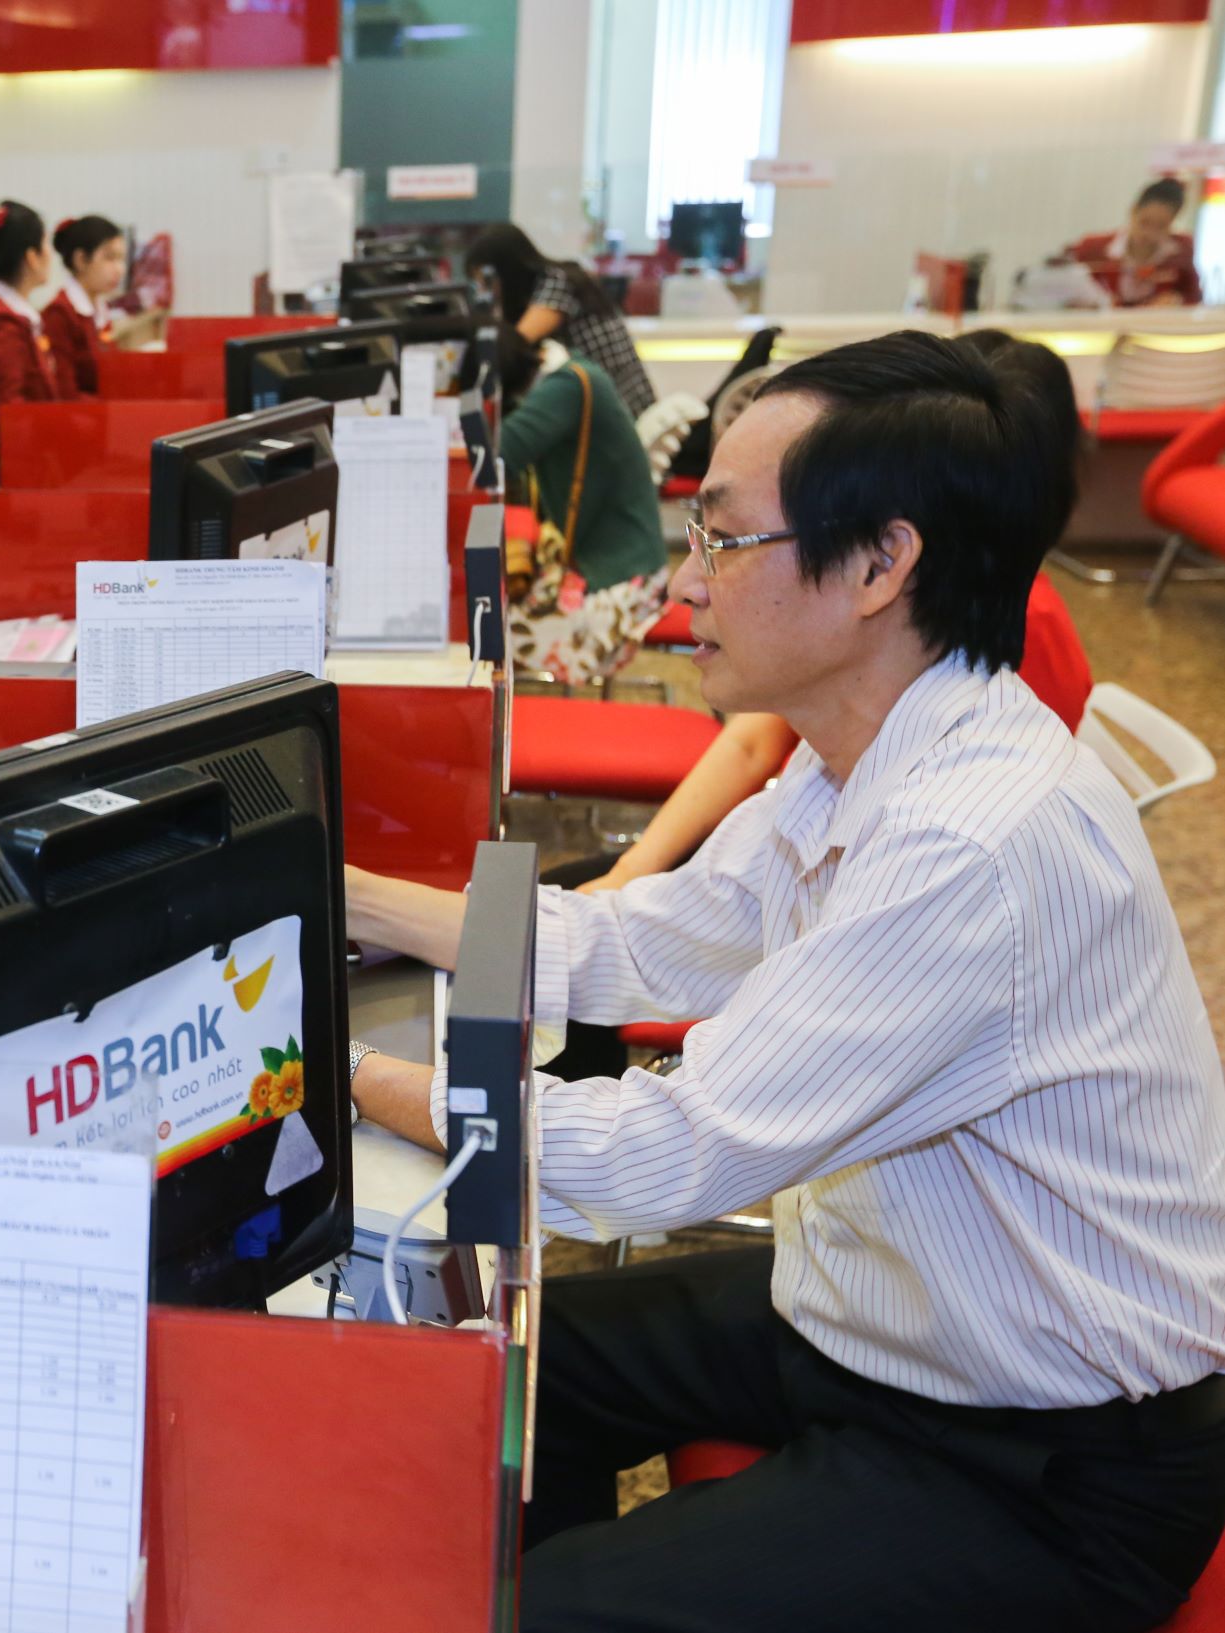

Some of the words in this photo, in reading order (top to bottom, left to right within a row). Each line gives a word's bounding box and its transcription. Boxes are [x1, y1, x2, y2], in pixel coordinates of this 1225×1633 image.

[93, 582, 145, 594] HDBank
[26, 1003, 225, 1136] HDBank
[208, 1058, 242, 1087] nhất
